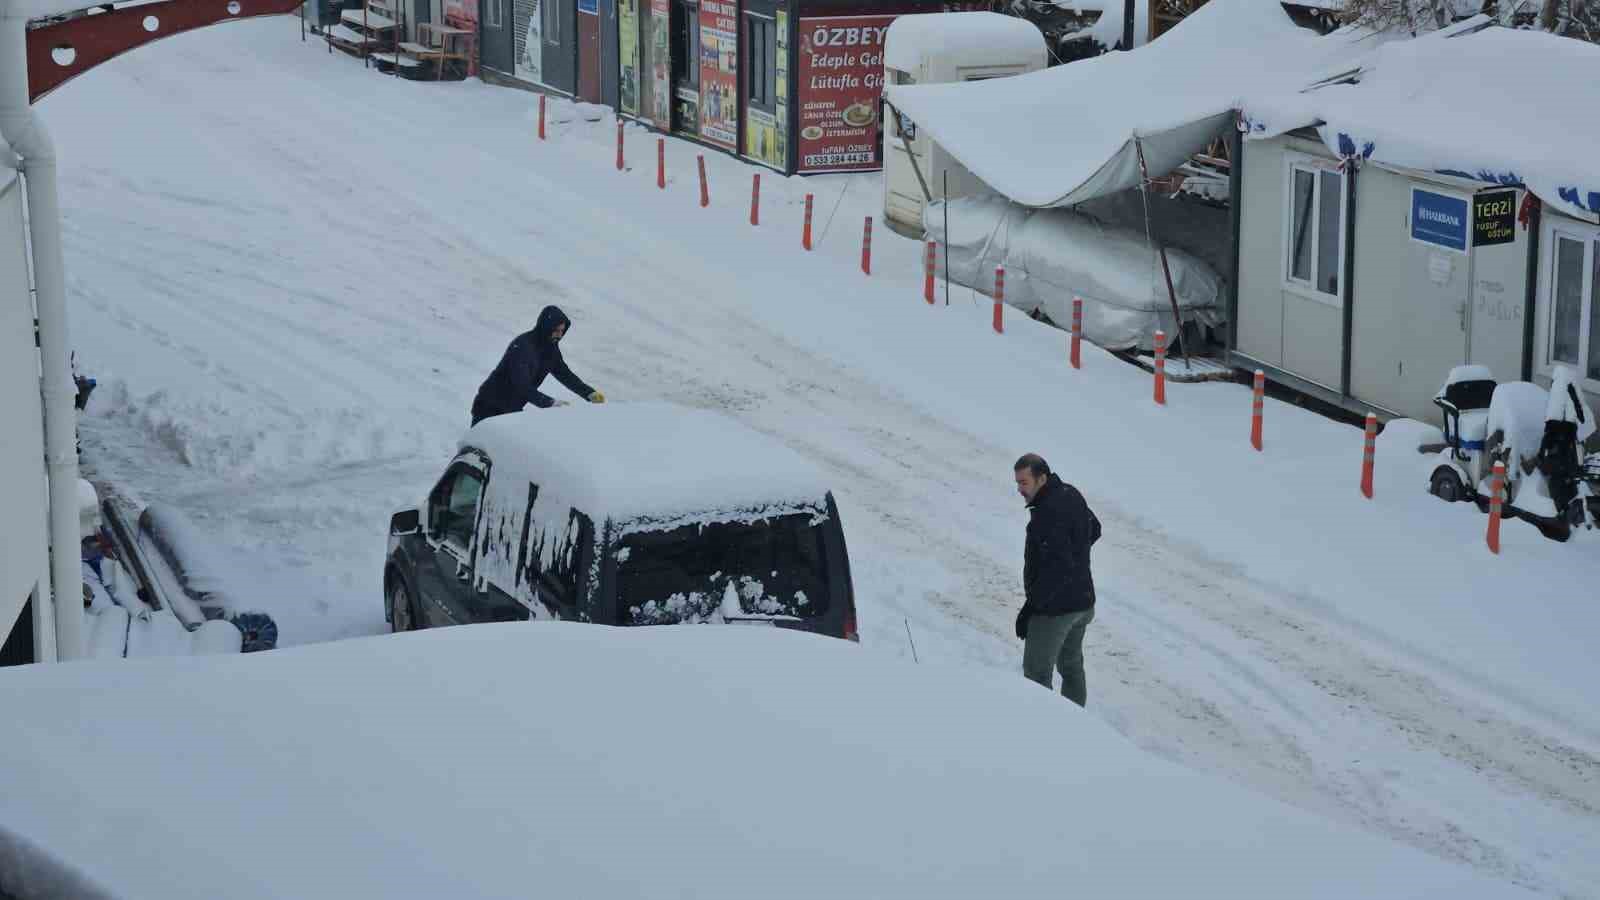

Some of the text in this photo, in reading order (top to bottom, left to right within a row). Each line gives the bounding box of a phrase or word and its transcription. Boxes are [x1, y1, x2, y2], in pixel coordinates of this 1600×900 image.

[813, 25, 887, 46] ÖZBEY
[810, 52, 855, 69] Edeple
[810, 73, 859, 91] Lütufla
[1476, 198, 1511, 218] TERZİ
